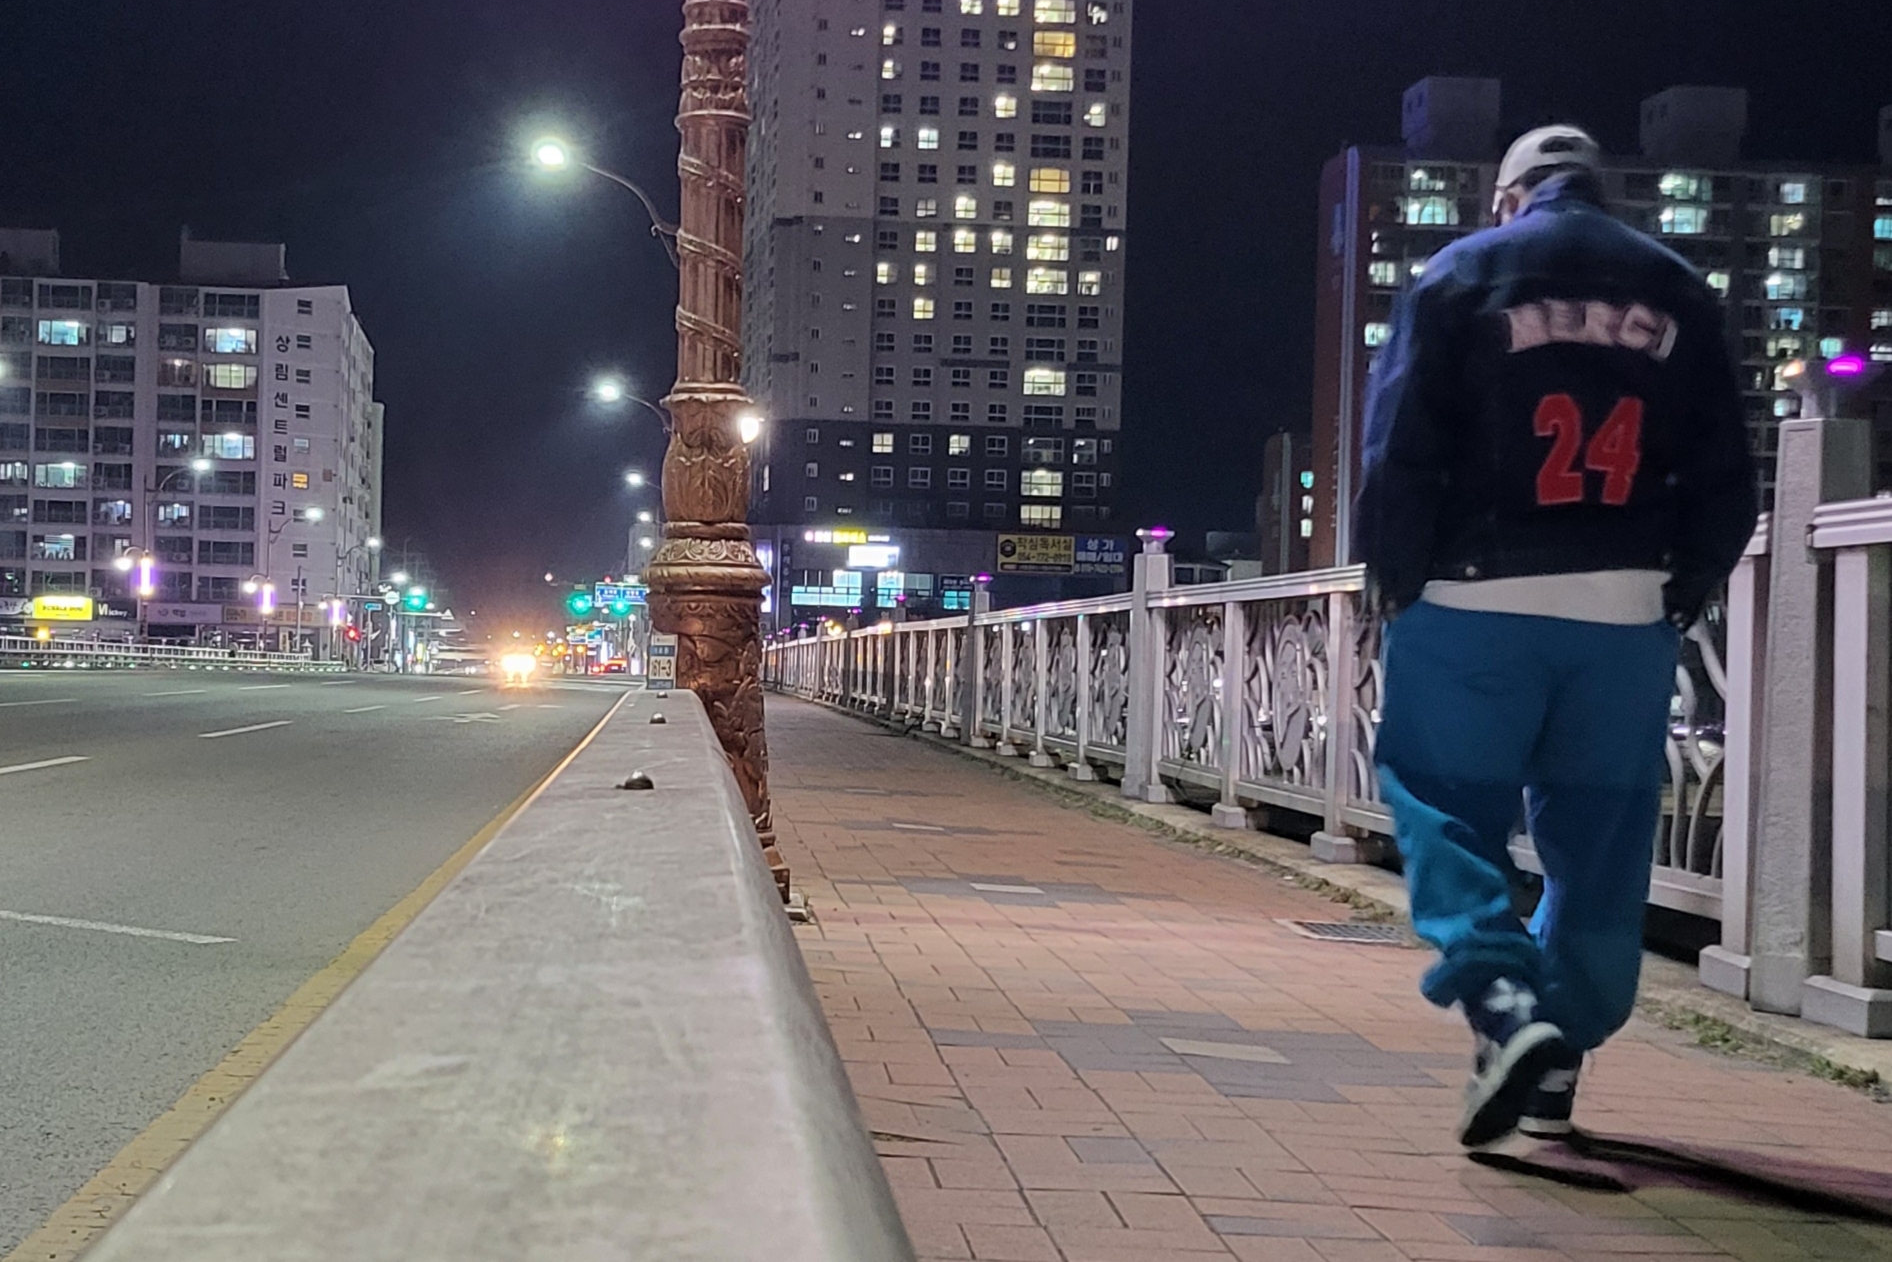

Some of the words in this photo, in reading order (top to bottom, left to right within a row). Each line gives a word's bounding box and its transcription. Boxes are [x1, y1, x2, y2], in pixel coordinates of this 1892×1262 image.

[271, 334, 291, 516] 상림센트럴파크
[1533, 393, 1643, 505] 24
[1017, 537, 1072, 551] 작심독서실
